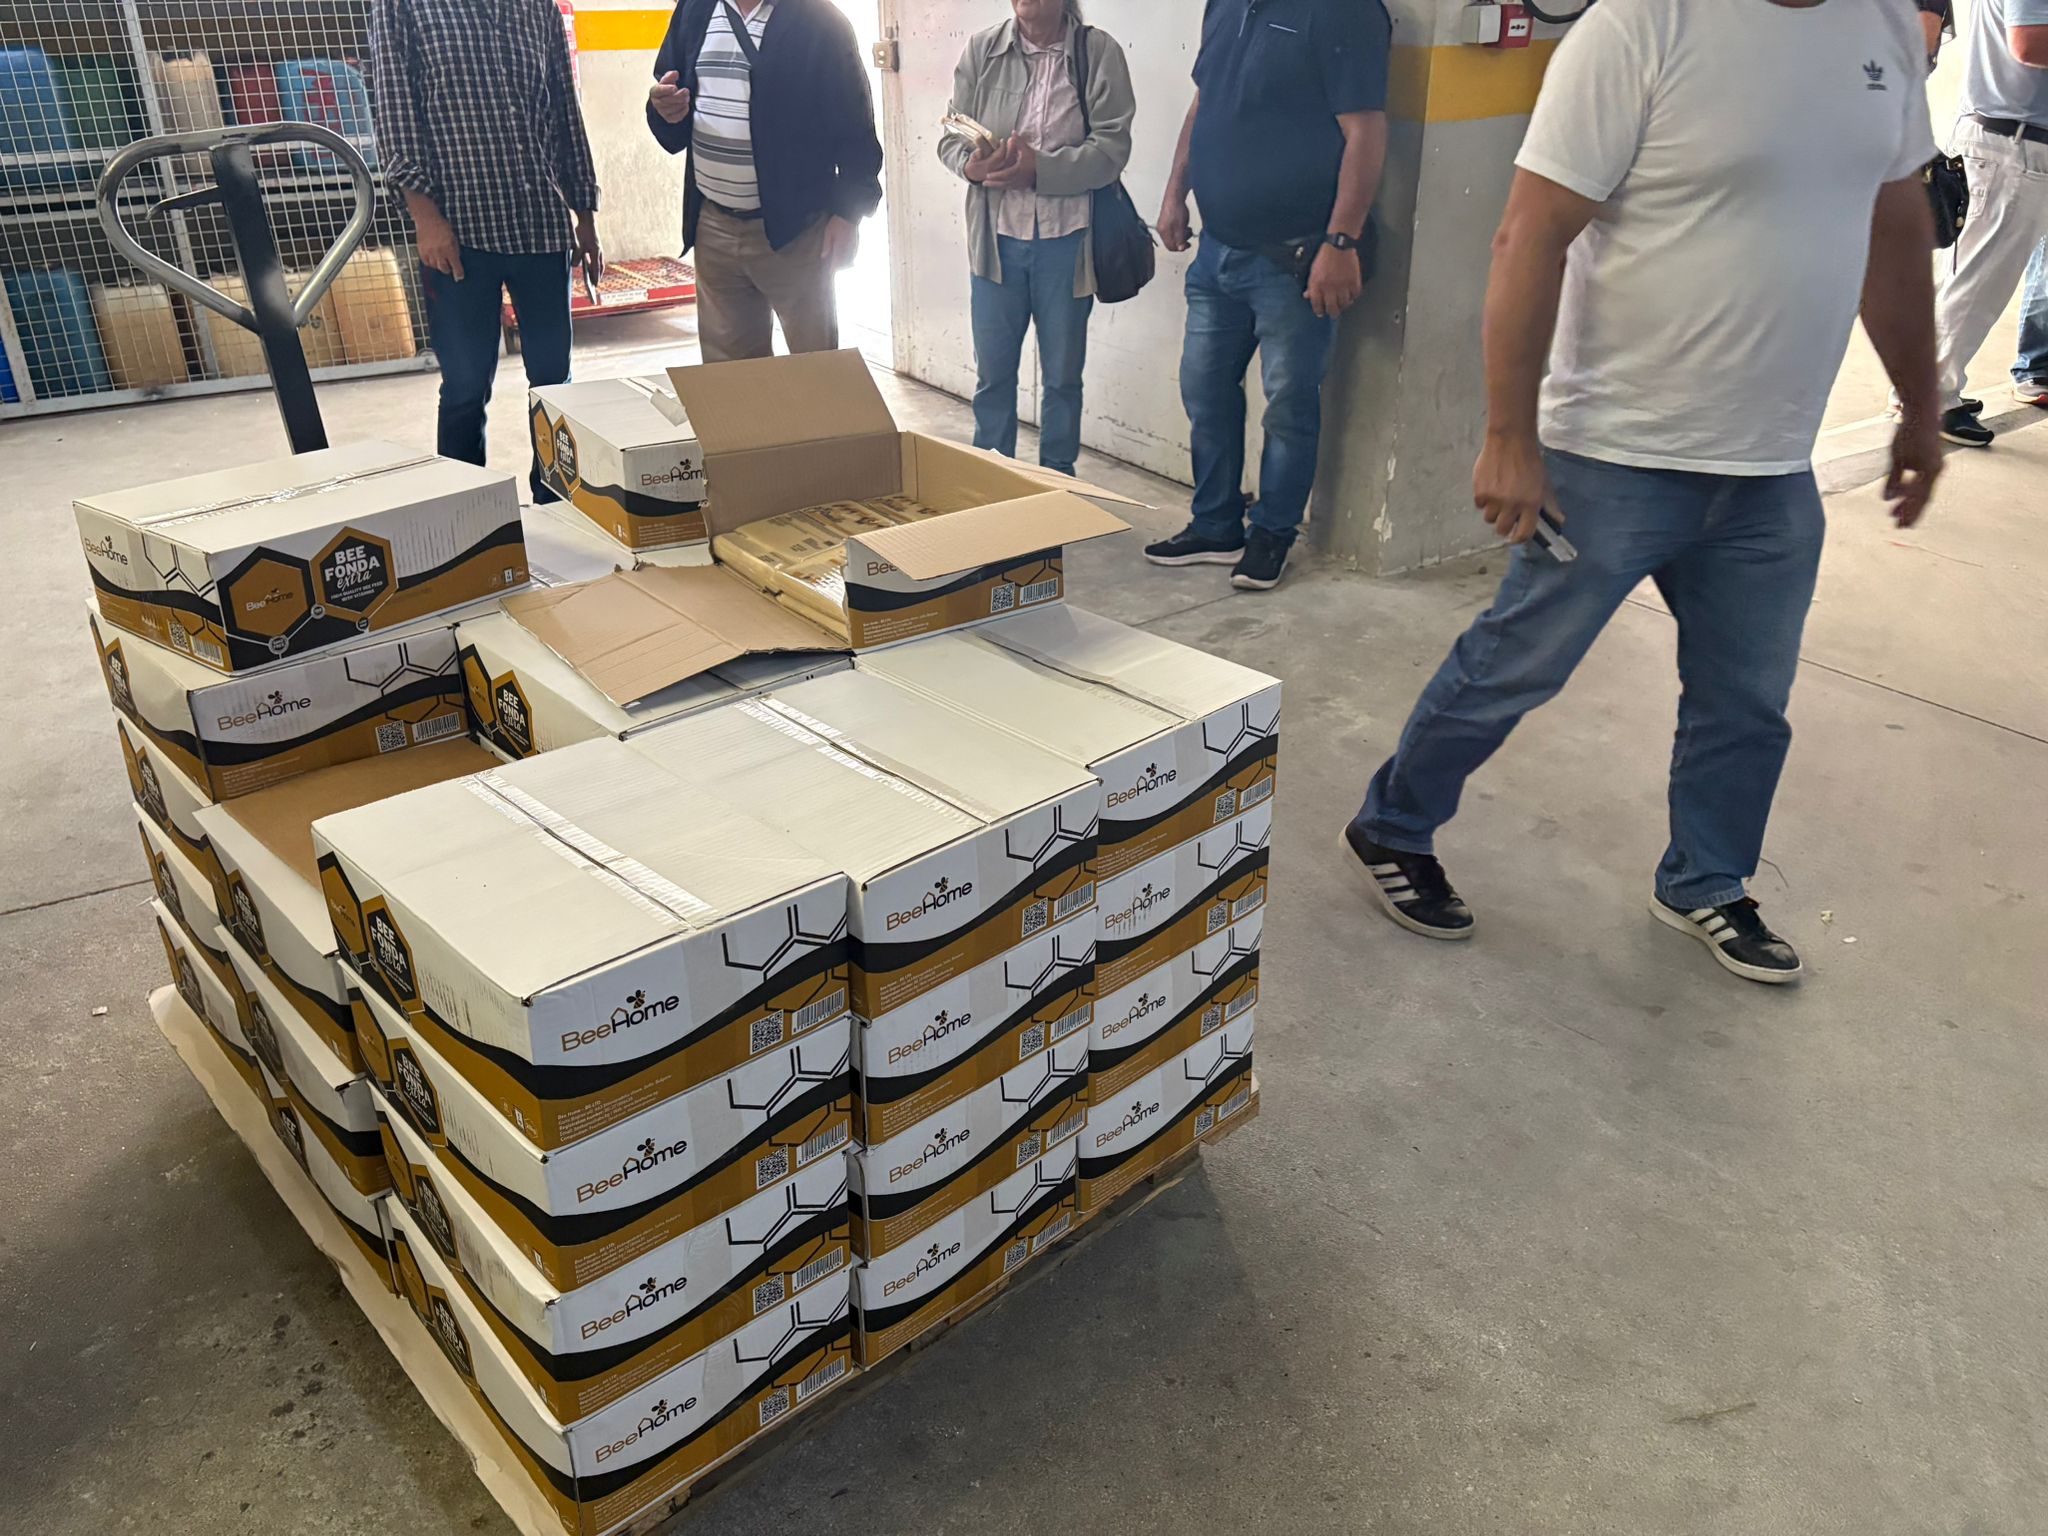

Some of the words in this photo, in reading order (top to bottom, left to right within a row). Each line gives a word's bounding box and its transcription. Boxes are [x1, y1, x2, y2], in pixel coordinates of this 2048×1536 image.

[641, 466, 703, 486] BeeHom
[85, 537, 128, 565] BeeHome
[324, 556, 380, 581] FONDA
[335, 545, 365, 565] BEE
[337, 571, 371, 591] extra
[217, 697, 312, 731] BeeHome
[498, 698, 526, 727] FONDA
[503, 688, 519, 709] BEE
[1107, 769, 1177, 808] BeeHome
[886, 881, 973, 931] BeeHome
[1105, 887, 1171, 930] BeeHome
[371, 926, 408, 969] FONDA
[376, 916, 397, 946] BEE
[561, 995, 680, 1052] BeeHome
[888, 1012, 971, 1064] BeeHome
[1102, 995, 1167, 1040] BeeHome
[402, 1053, 422, 1083] BEE
[1096, 1102, 1160, 1148] BeeHome
[576, 1138, 687, 1203] BeeHome
[889, 1128, 970, 1183] BeeHome
[883, 1242, 961, 1297] BeeHome
[580, 1275, 687, 1340] BeeHome
[595, 1396, 698, 1463] BeeHome
